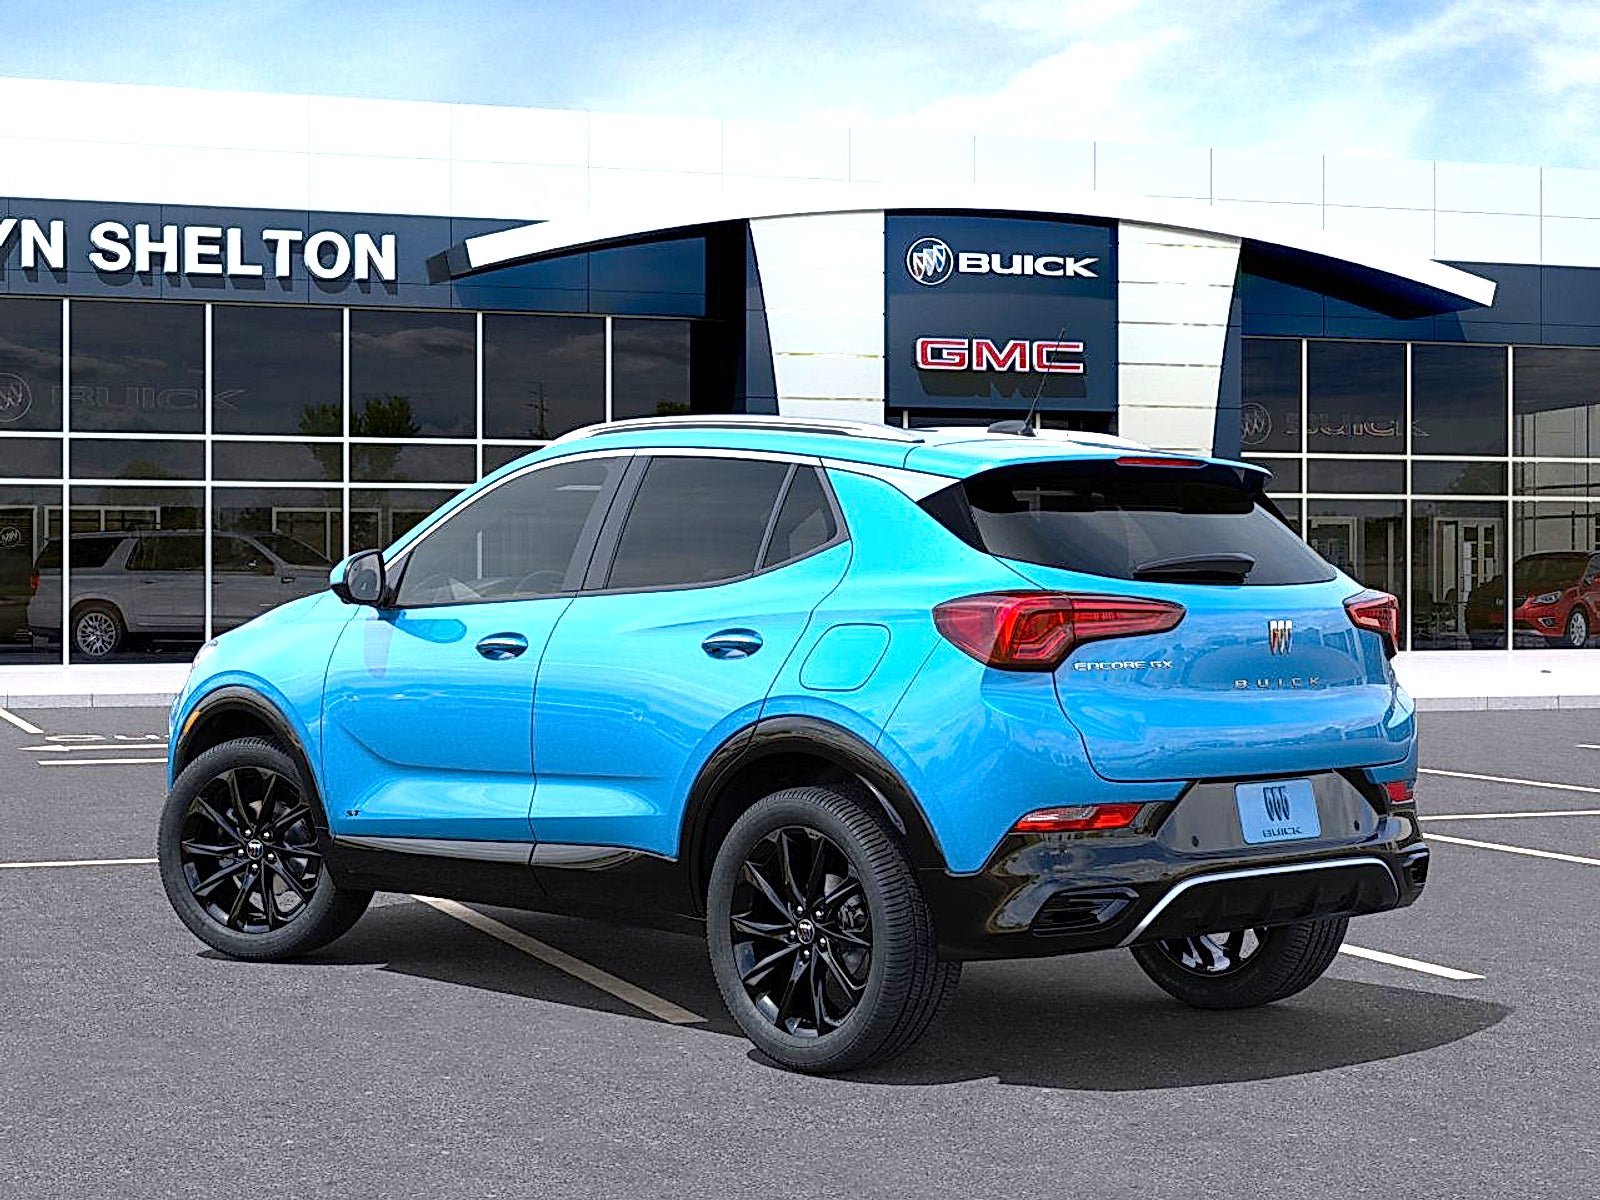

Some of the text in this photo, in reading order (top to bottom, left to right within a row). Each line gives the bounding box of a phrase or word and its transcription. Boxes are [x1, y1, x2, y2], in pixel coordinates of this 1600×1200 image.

[88, 221, 396, 281] SHELTON
[958, 252, 1099, 278] BUICK
[916, 337, 1084, 373] GMC
[1074, 660, 1173, 671] ENCORE GX
[1234, 677, 1319, 688] BUICK
[1262, 826, 1302, 838] BUICK
